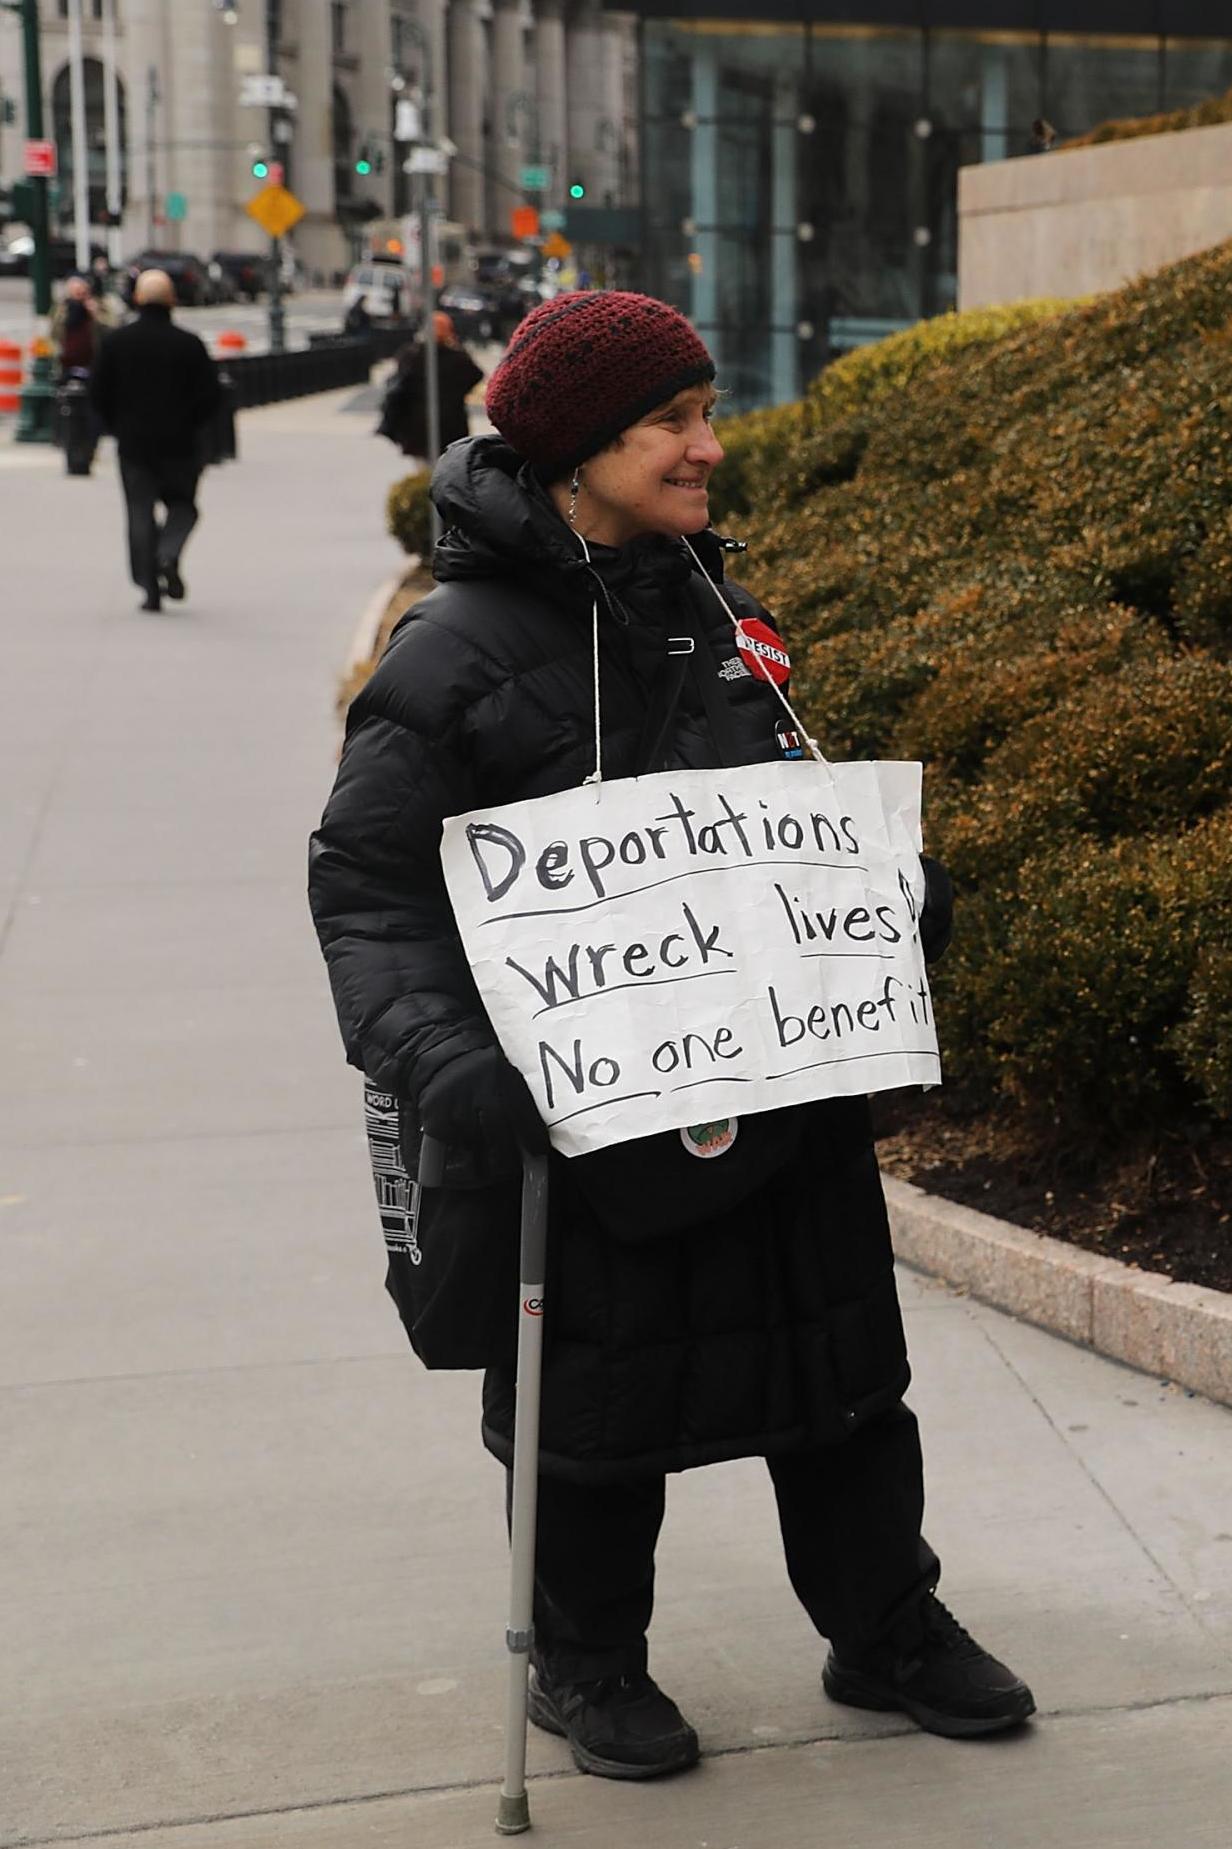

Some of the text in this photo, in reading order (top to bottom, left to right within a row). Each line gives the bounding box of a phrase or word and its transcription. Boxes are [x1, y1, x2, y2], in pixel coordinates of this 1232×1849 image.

[465, 793, 860, 903] Deportations
[539, 976, 929, 1110] No one benefit
